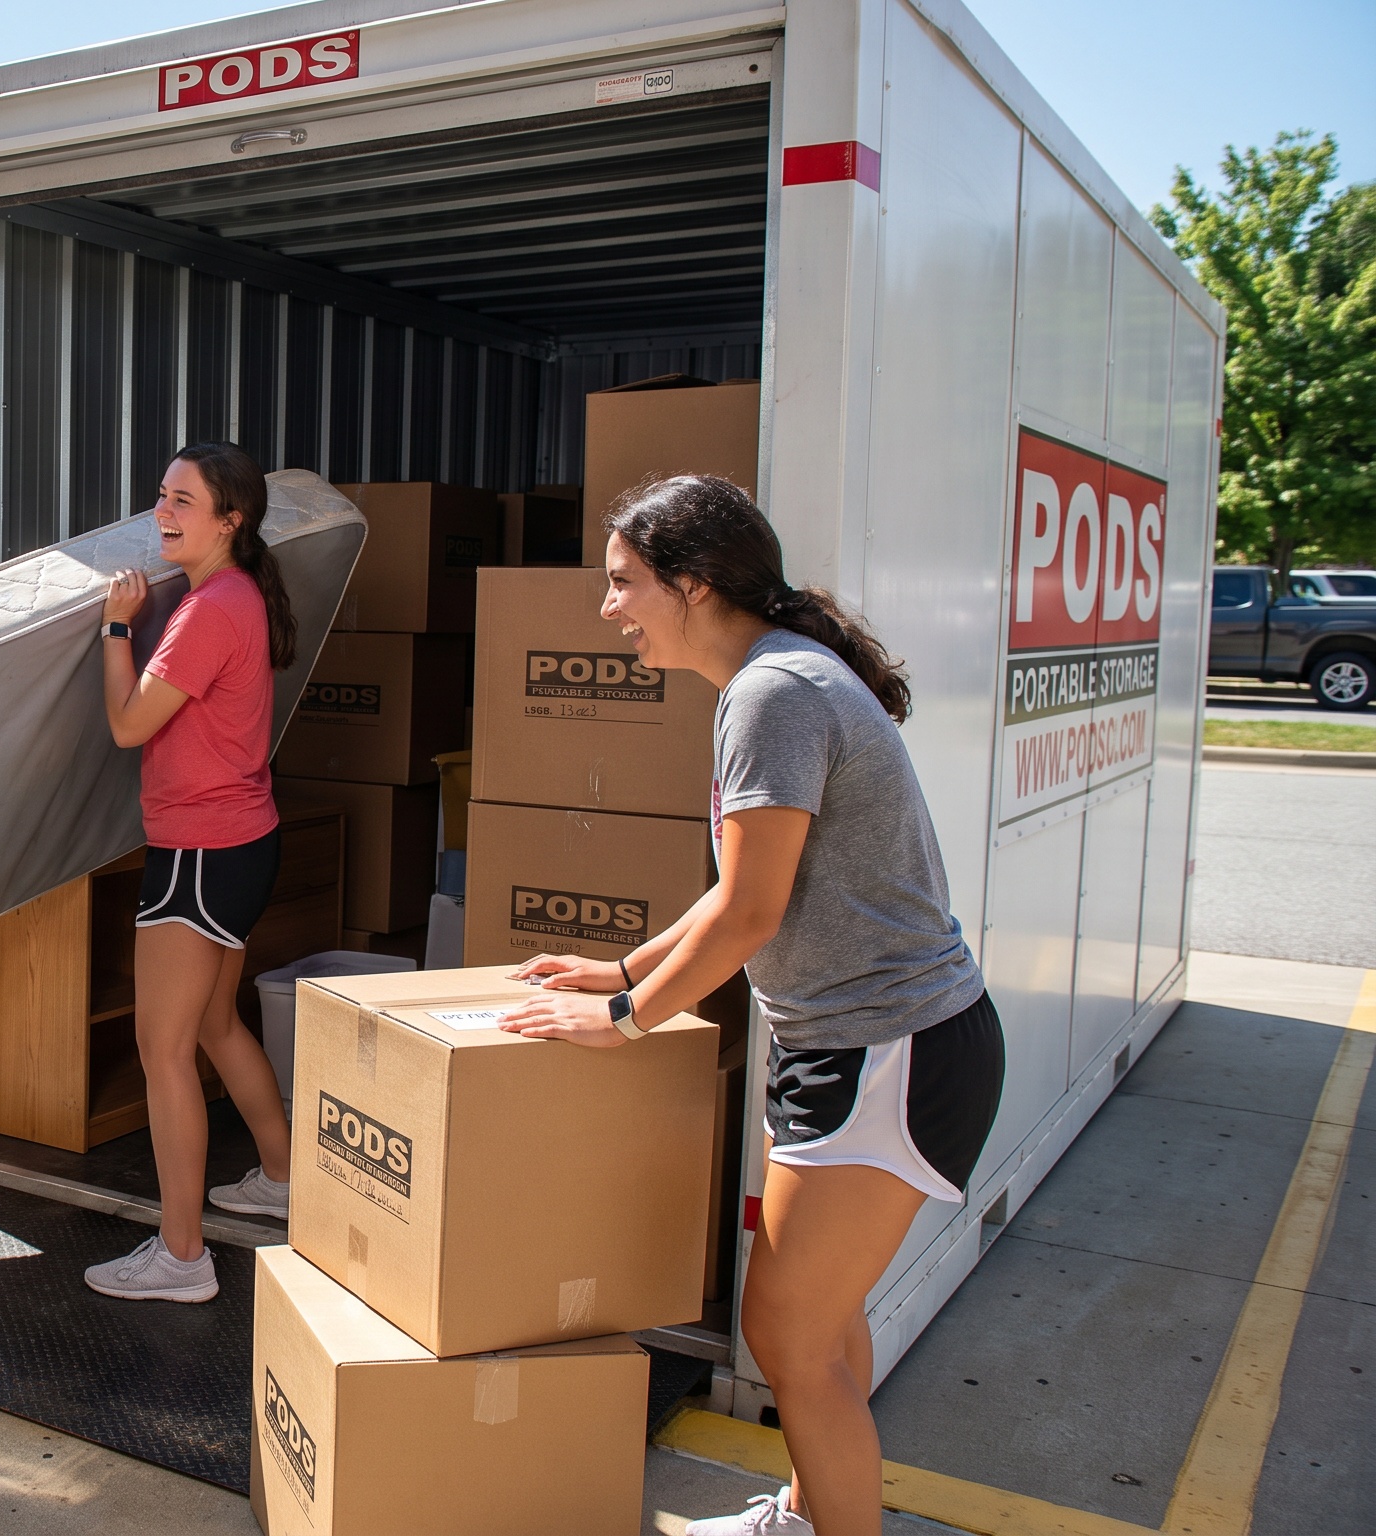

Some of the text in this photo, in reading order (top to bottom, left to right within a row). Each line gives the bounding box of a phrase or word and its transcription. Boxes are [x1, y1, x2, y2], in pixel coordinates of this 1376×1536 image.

[165, 37, 351, 106] PODS
[447, 538, 482, 556] PODS
[1015, 468, 1162, 623] PODS
[301, 685, 378, 705] PODS
[529, 656, 662, 686] PODS
[597, 690, 658, 701] STORAGE
[1011, 654, 1156, 715] PORTABLE STORAGE
[515, 890, 644, 931] PODS
[320, 1097, 409, 1175] PODS
[266, 1372, 315, 1477] PODS
